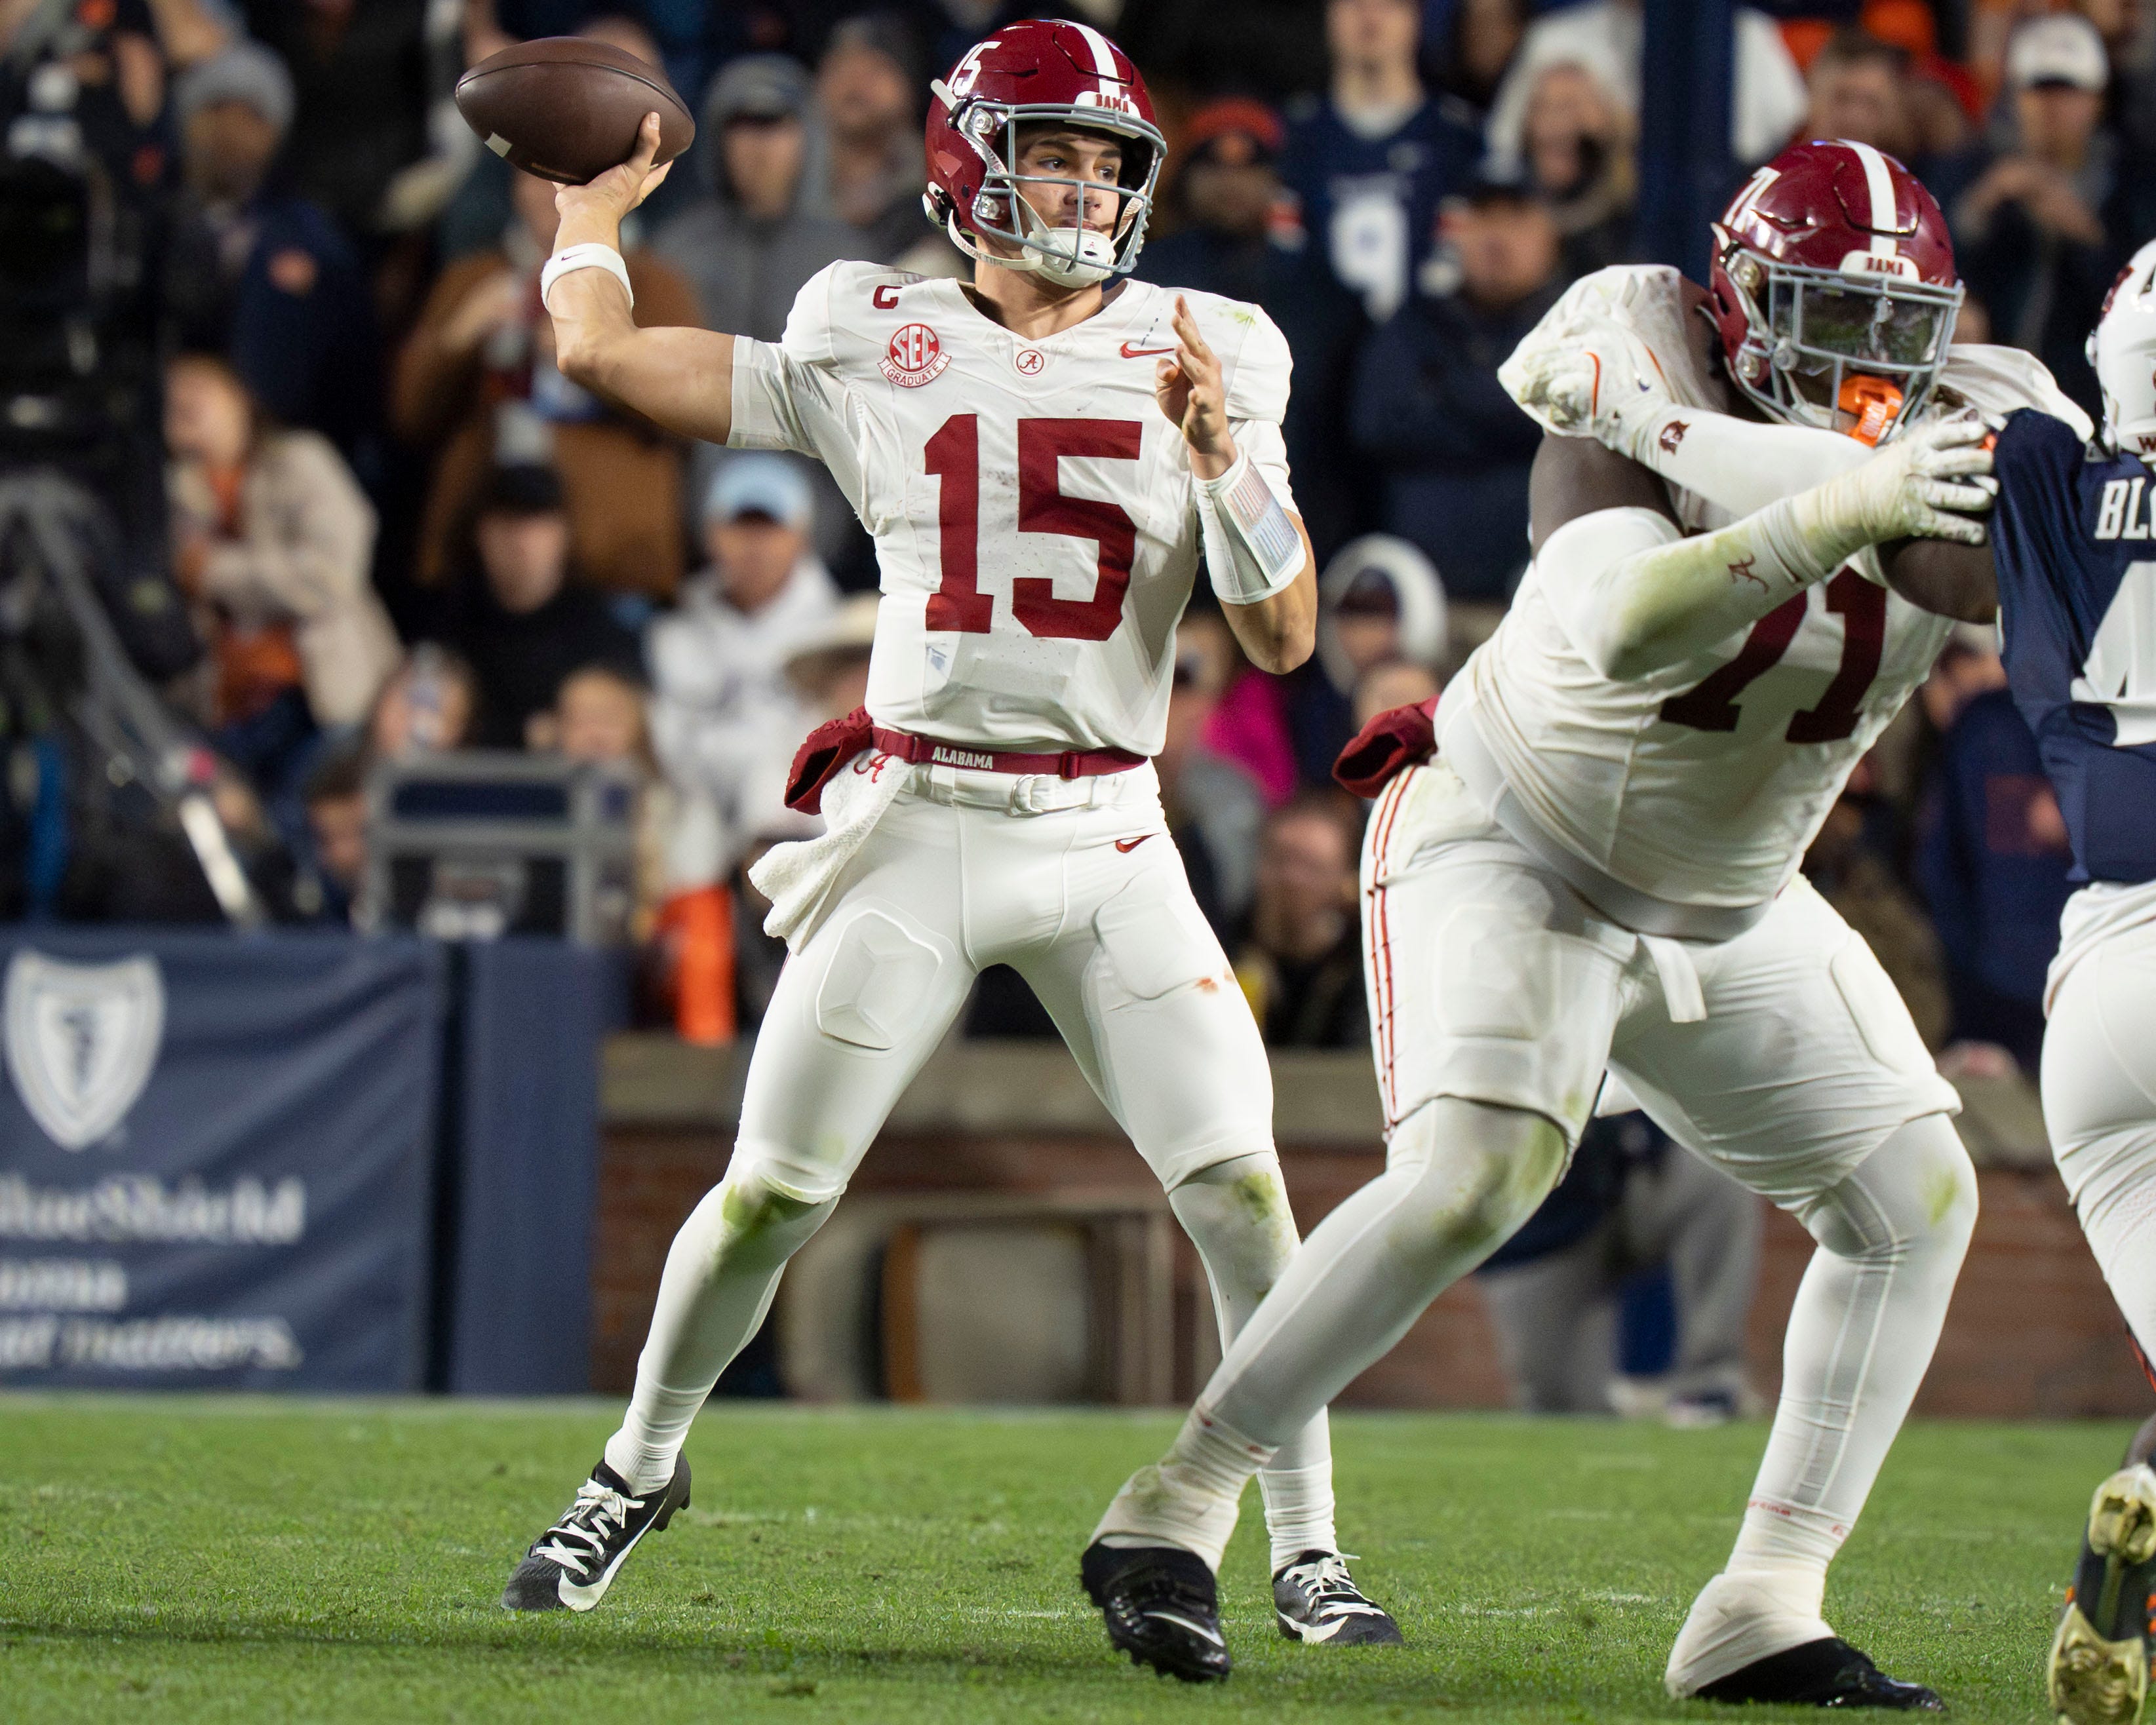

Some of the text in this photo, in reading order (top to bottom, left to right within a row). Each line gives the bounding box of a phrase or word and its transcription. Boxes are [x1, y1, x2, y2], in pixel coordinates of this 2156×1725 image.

[946, 41, 1002, 96] 15
[1095, 94, 1129, 113] BAMA
[872, 285, 903, 309] C
[892, 325, 937, 370] SEC
[887, 364, 941, 385] GRADUATE
[924, 413, 1143, 642] 15
[931, 746, 993, 769] ALABAMA
